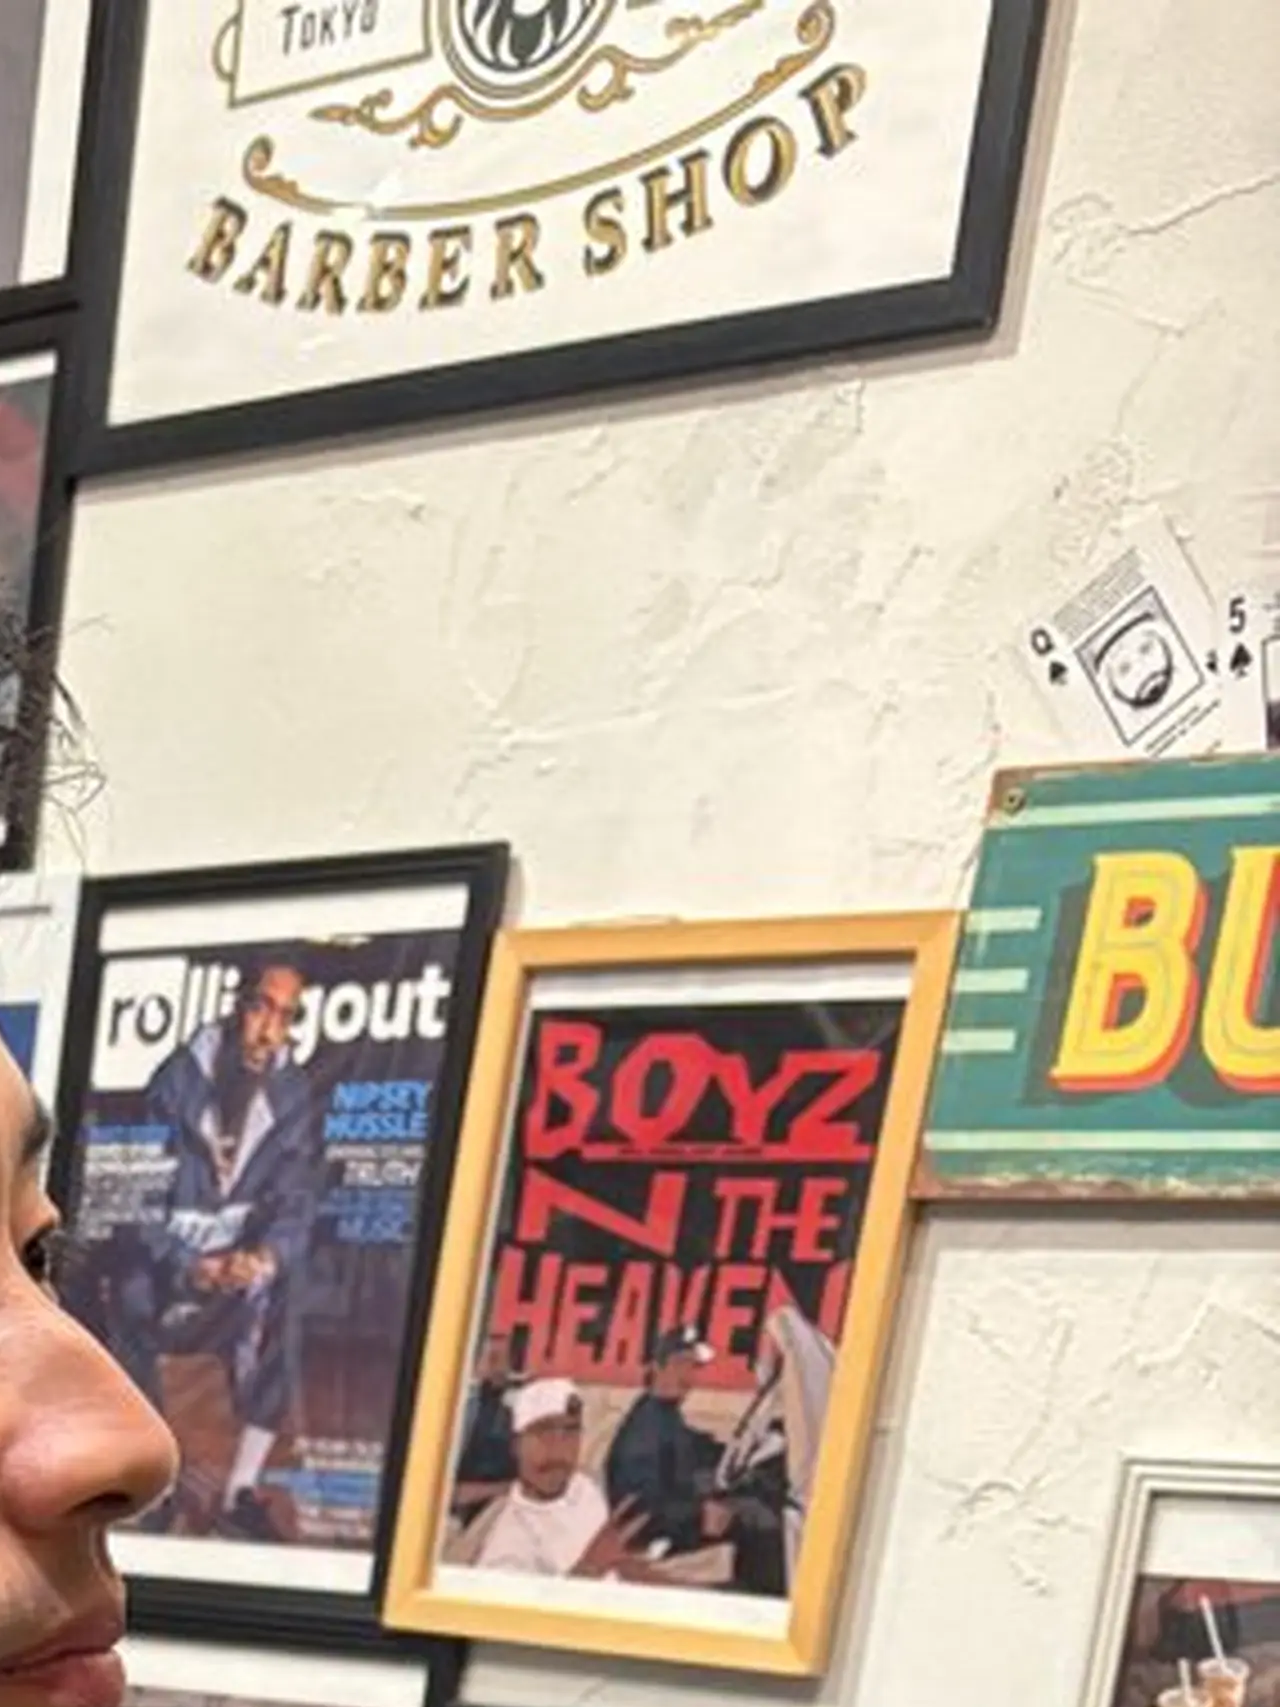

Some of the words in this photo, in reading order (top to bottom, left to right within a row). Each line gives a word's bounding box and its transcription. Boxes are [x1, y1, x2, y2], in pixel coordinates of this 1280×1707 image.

[280, 2, 377, 54] TOKYO
[184, 195, 546, 315] BARBER
[583, 62, 868, 279] SHOP
[1228, 596, 1246, 634] 5
[526, 1020, 882, 1160] BOYZ
[518, 1164, 688, 1257] N
[714, 1176, 848, 1262] THE
